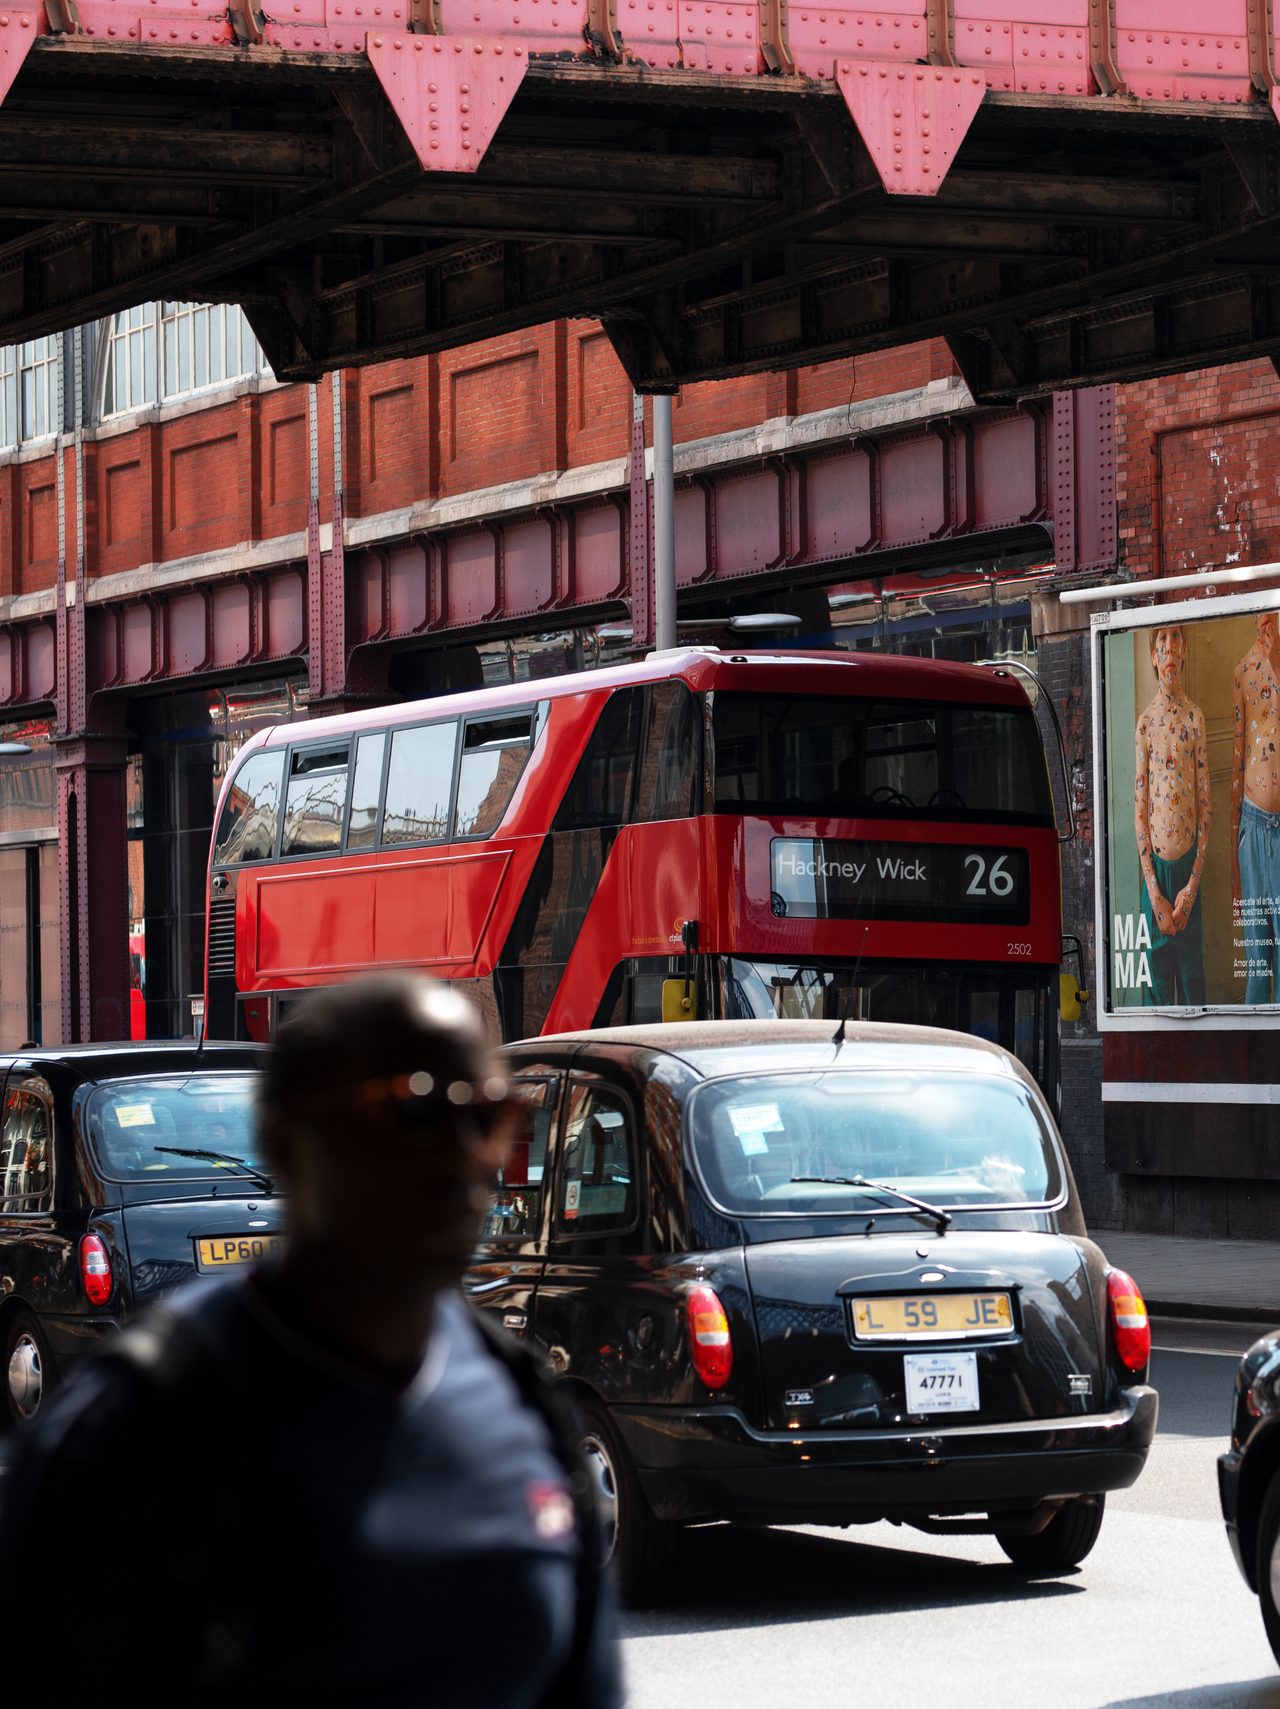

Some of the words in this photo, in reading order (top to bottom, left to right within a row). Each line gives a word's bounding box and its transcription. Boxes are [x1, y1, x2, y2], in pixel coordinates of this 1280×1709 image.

[778, 854, 866, 884] Hackney
[876, 858, 926, 881] Wick
[964, 854, 1014, 896] 26
[1114, 913, 1152, 950] MA
[1007, 943, 1032, 955] 2502
[1233, 938, 1254, 947] Nuestro
[1114, 951, 1153, 988] MA
[1233, 958, 1248, 968] Amor
[1233, 969, 1248, 978] amor
[210, 1241, 263, 1261] LP60
[866, 1304, 884, 1329] L
[904, 1301, 938, 1327] 59
[965, 1298, 998, 1325] JE
[919, 1375, 962, 1389] 47771
